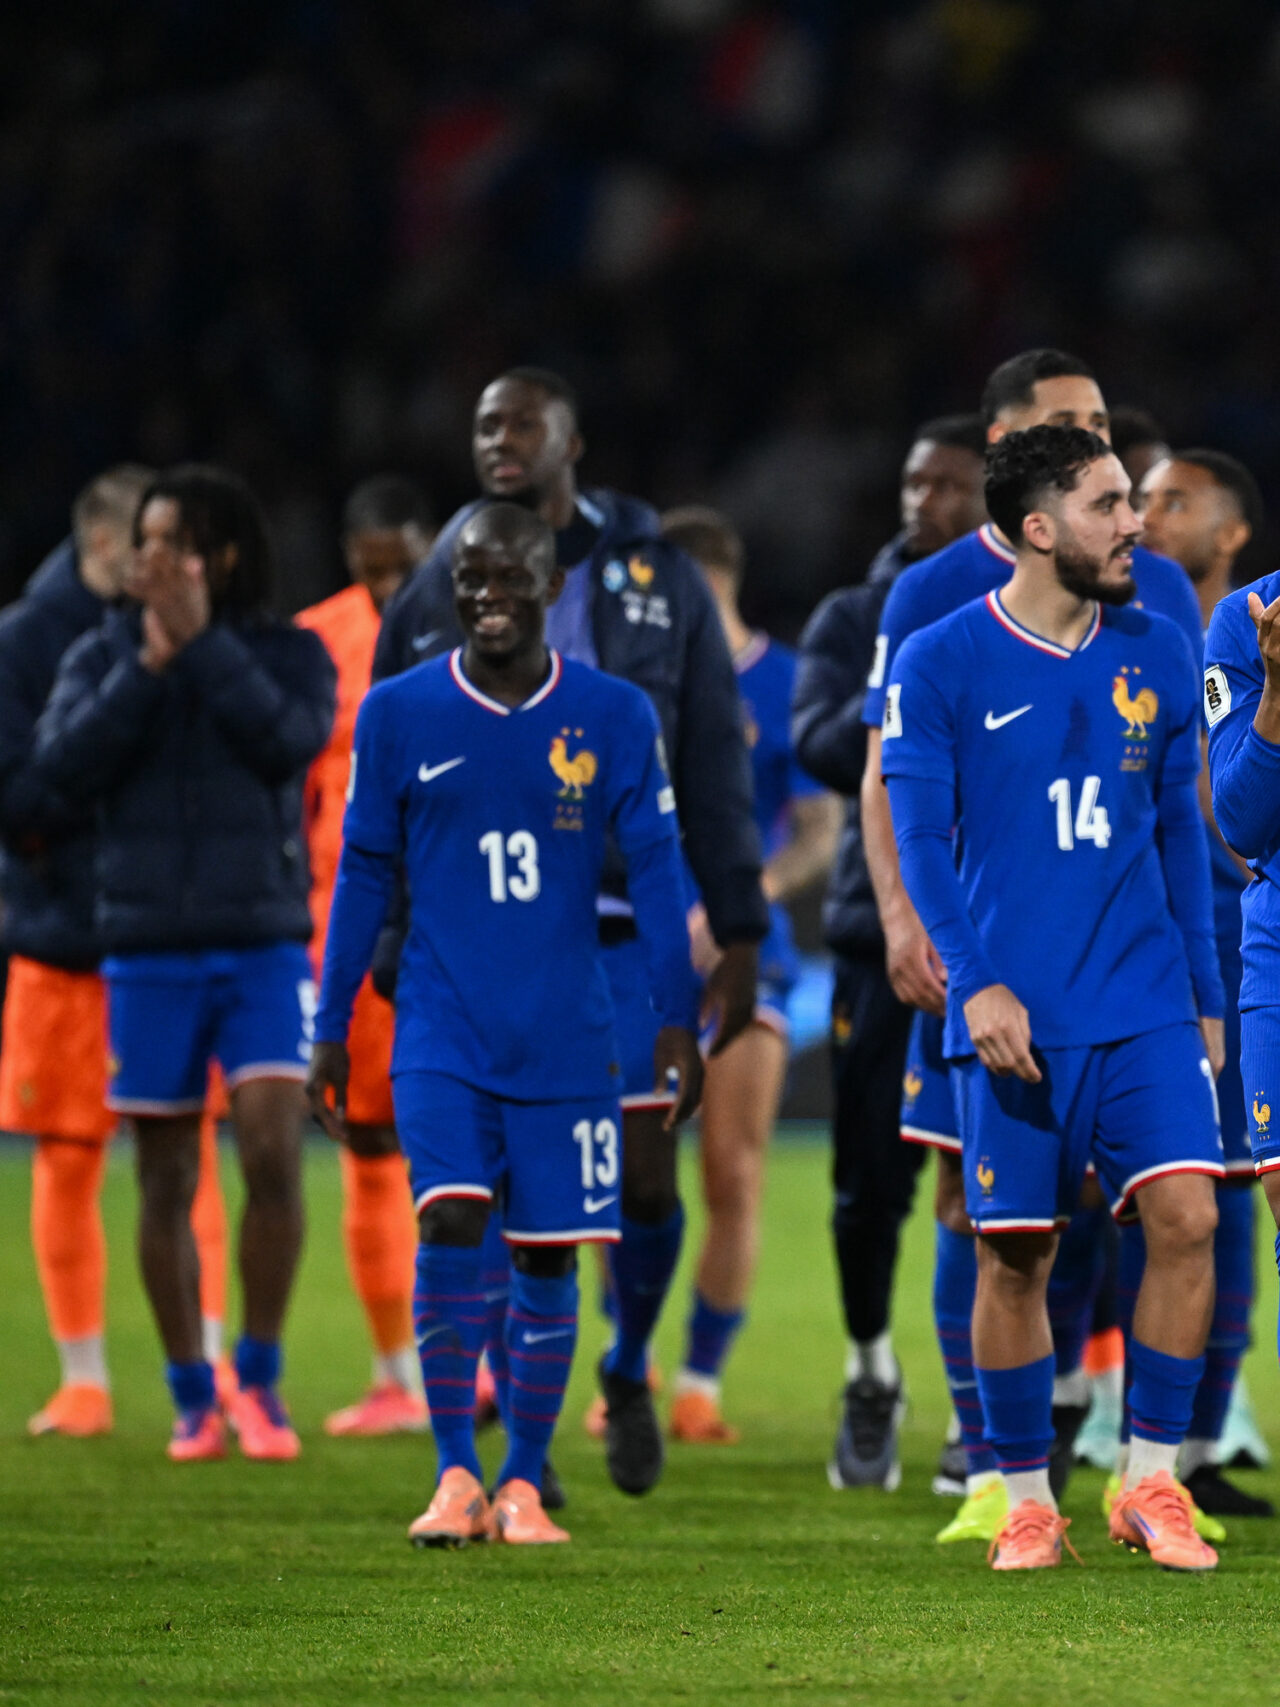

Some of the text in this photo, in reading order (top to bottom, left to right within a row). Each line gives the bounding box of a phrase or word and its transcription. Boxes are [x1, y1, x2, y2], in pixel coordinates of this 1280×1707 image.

[1047, 774, 1112, 852] 14
[478, 829, 540, 903] 13
[572, 1117, 619, 1189] 13
